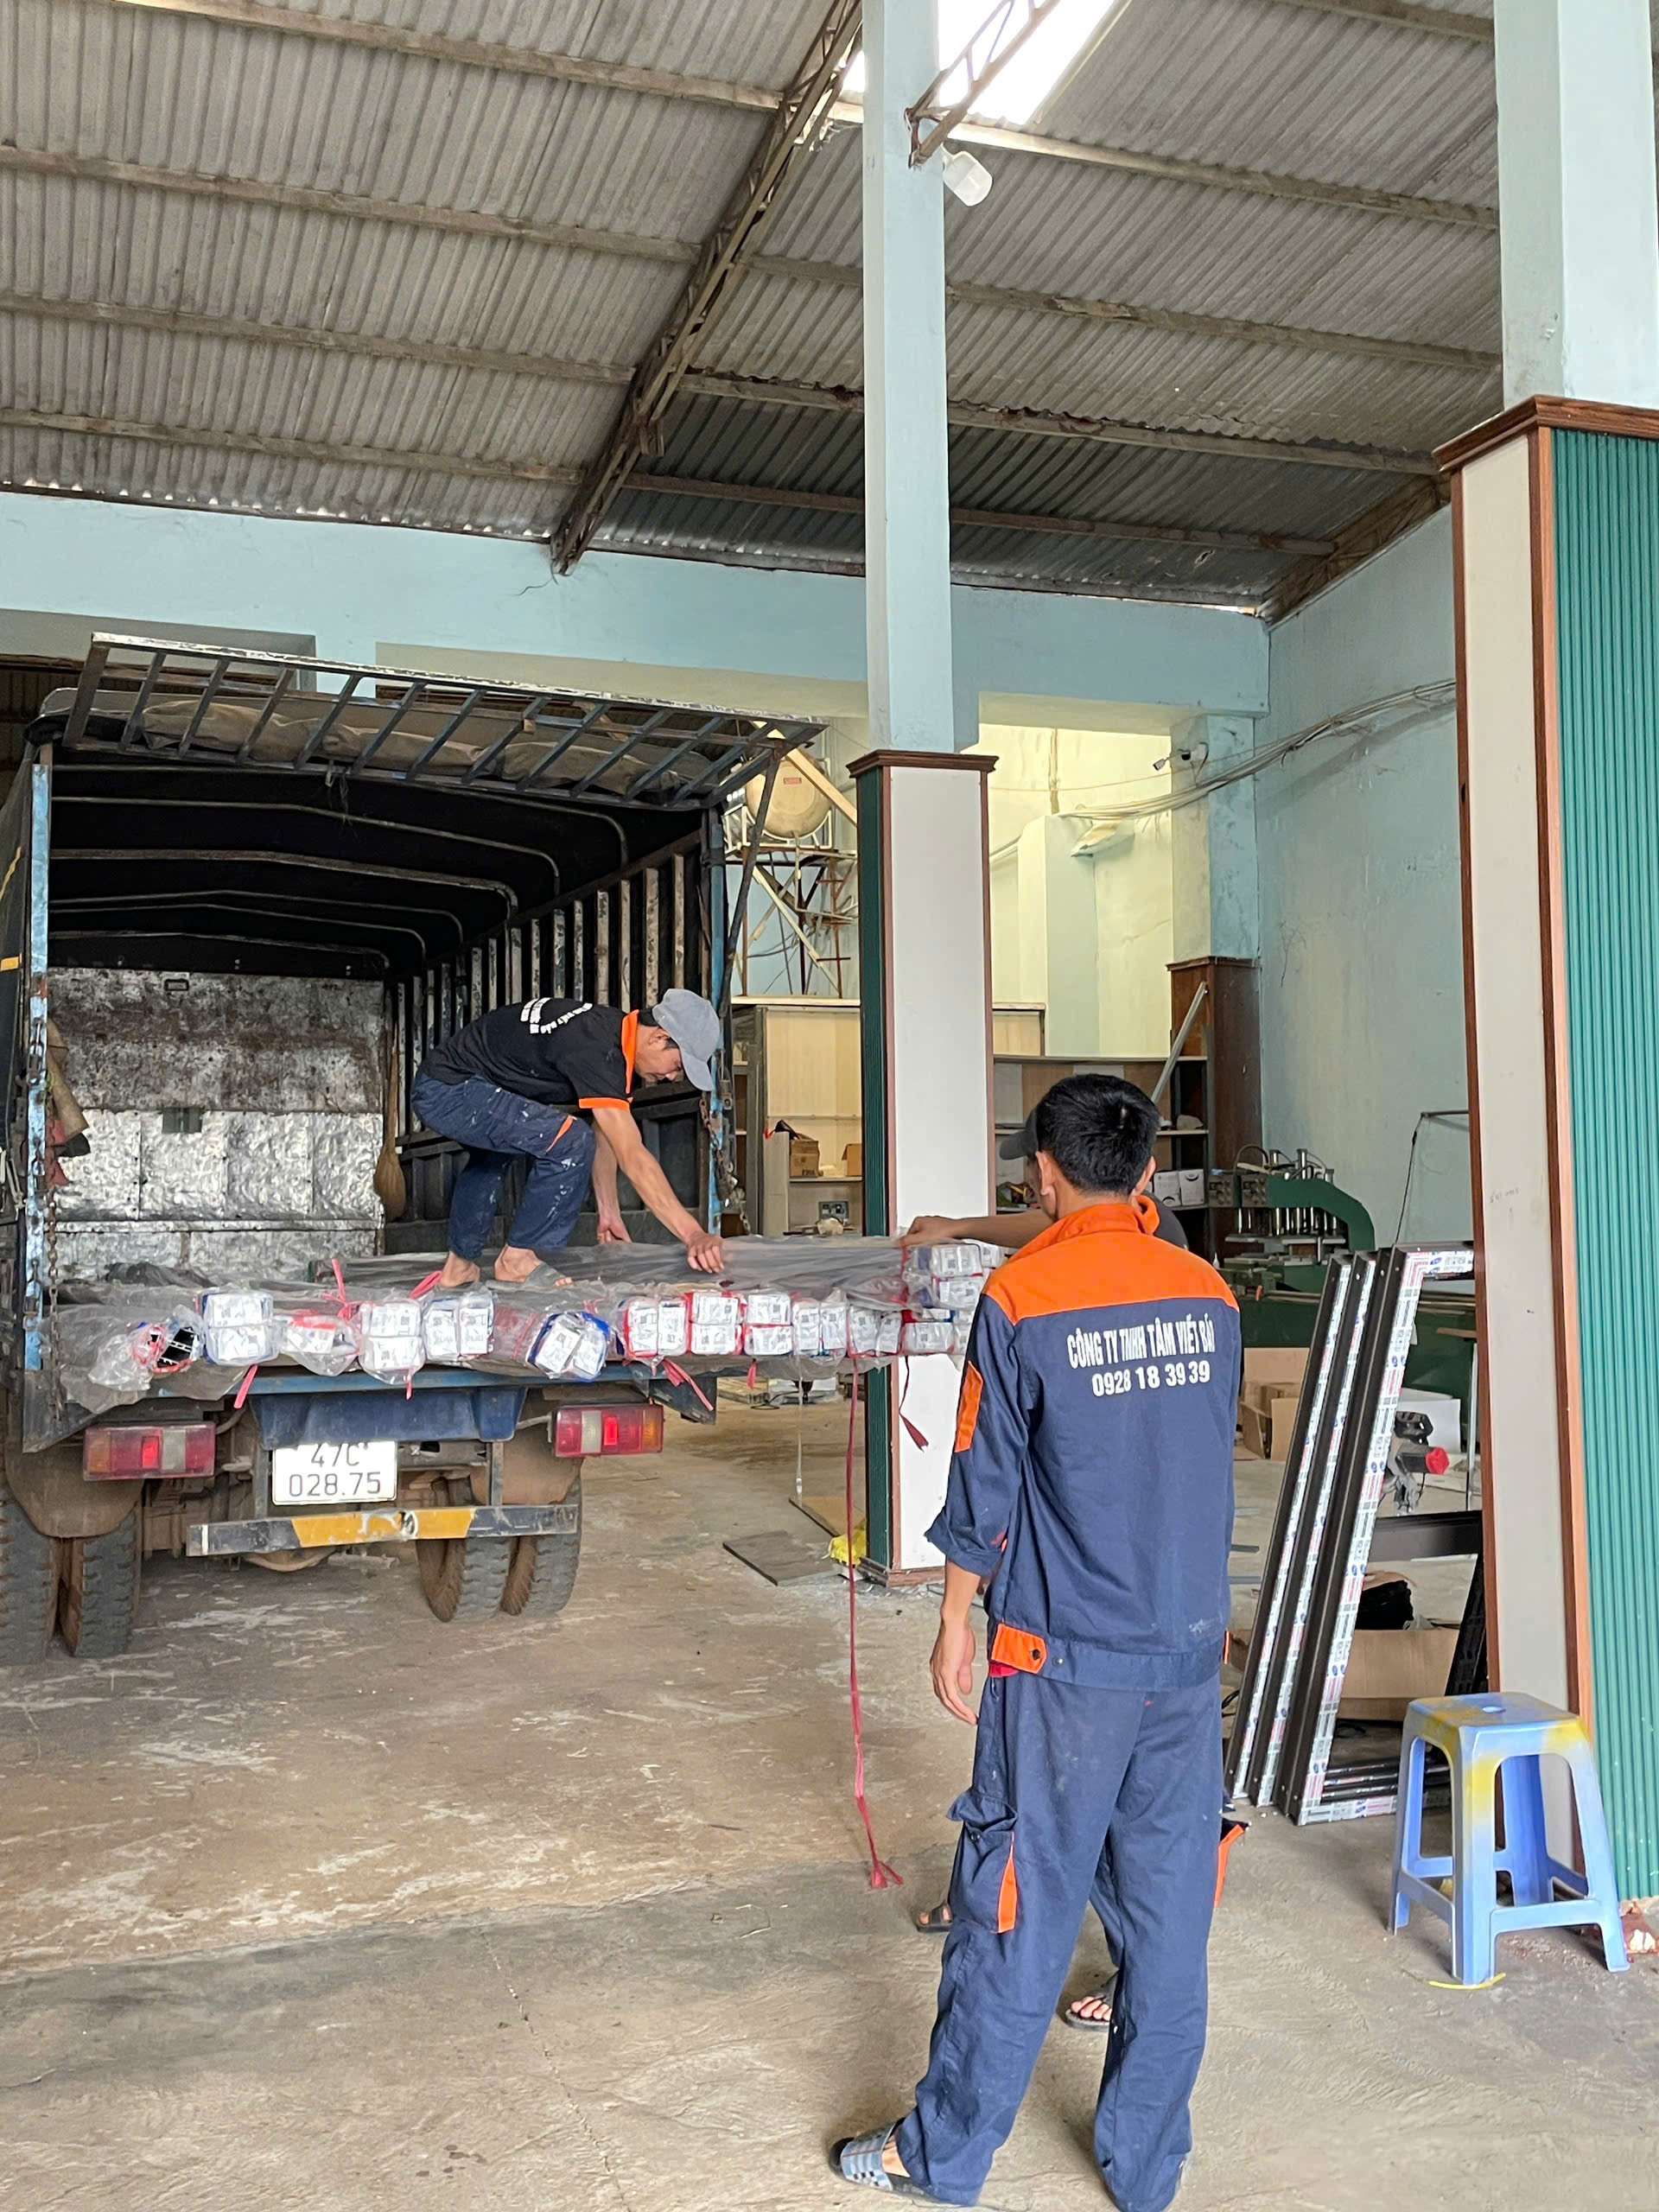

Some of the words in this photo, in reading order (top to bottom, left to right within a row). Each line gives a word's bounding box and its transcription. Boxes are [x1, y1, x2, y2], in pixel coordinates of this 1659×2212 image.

[1067, 1327, 1104, 1369] CÔNG
[1103, 1329, 1118, 1364] TY
[1119, 1325, 1147, 1361] TNHH
[1147, 1317, 1177, 1357] TÂM
[1091, 1369, 1132, 1396] 0928
[1135, 1365, 1160, 1389] 18
[289, 1471, 381, 1497] 028.75
